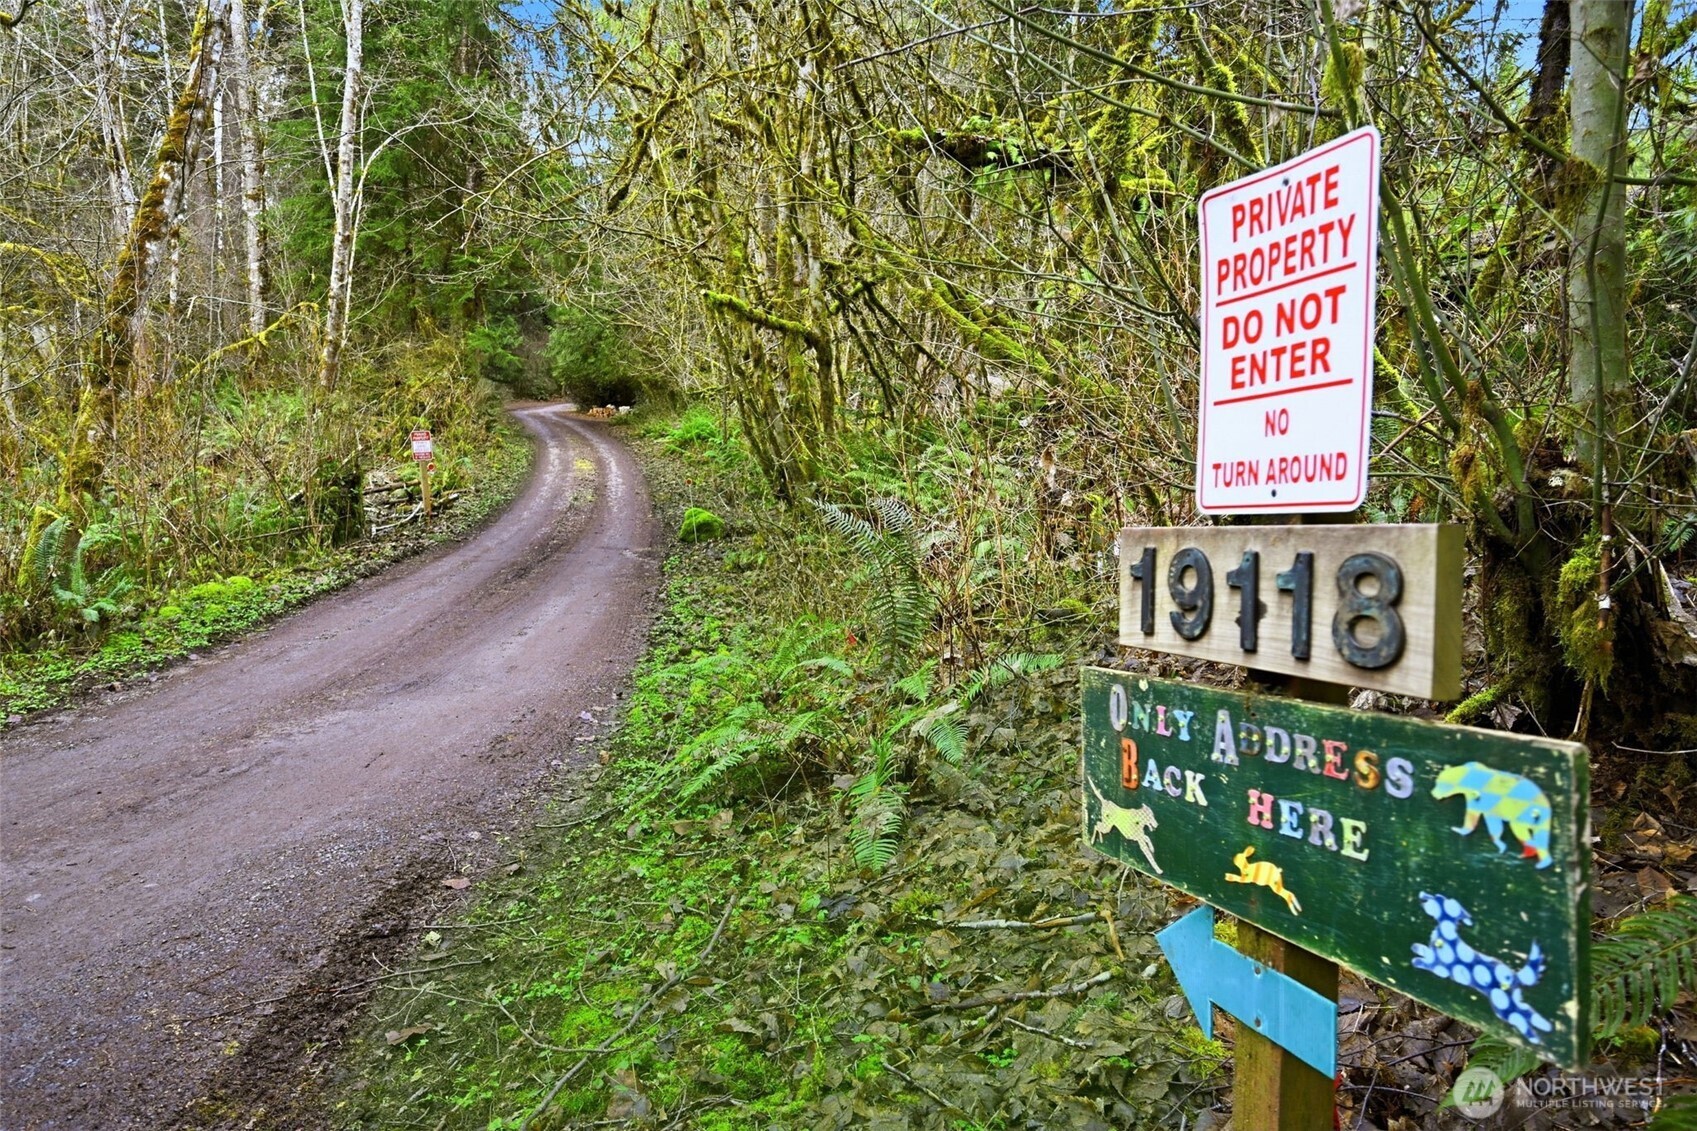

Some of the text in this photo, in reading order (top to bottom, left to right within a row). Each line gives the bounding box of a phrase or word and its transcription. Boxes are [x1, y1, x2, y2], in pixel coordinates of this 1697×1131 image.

[1232, 164, 1340, 243] PRIVATE
[1217, 213, 1356, 296] PROPERTY
[1222, 284, 1347, 350] DO NOT
[1231, 337, 1331, 390] ENTER
[1264, 408, 1289, 438] NO
[1212, 452, 1347, 488] TURN AROUND
[1130, 546, 1406, 670] 19118
[1109, 683, 1414, 799] ONLY ADDRESS
[1120, 737, 1370, 862] BACK HERE
